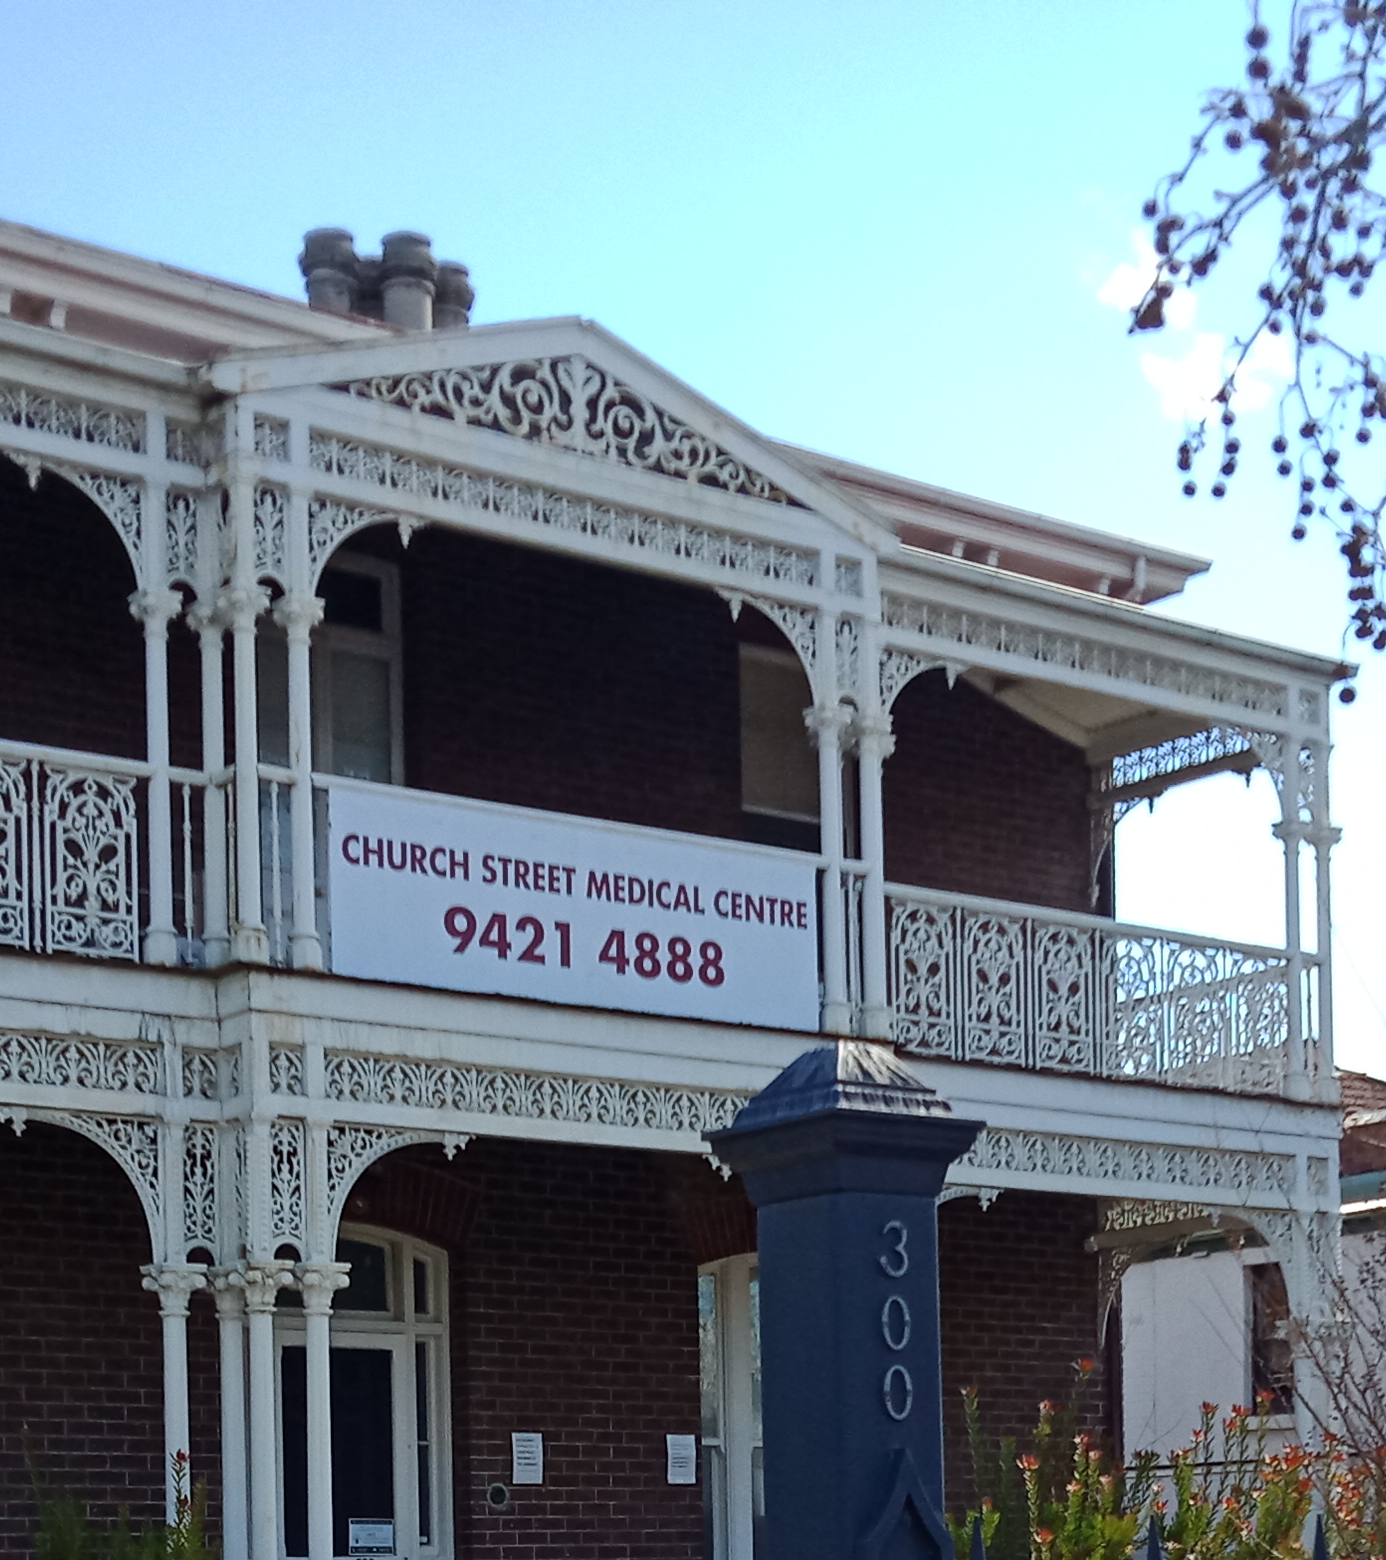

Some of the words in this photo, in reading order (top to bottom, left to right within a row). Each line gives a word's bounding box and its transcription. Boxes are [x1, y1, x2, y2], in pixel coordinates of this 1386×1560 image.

[341, 833, 470, 881] CHURCH
[481, 854, 576, 896] STREET
[586, 870, 705, 916] MEDICAL
[713, 889, 808, 930] CENTRE
[443, 905, 571, 969] 9421
[598, 929, 725, 988] 4888
[879, 1219, 913, 1421] 300
